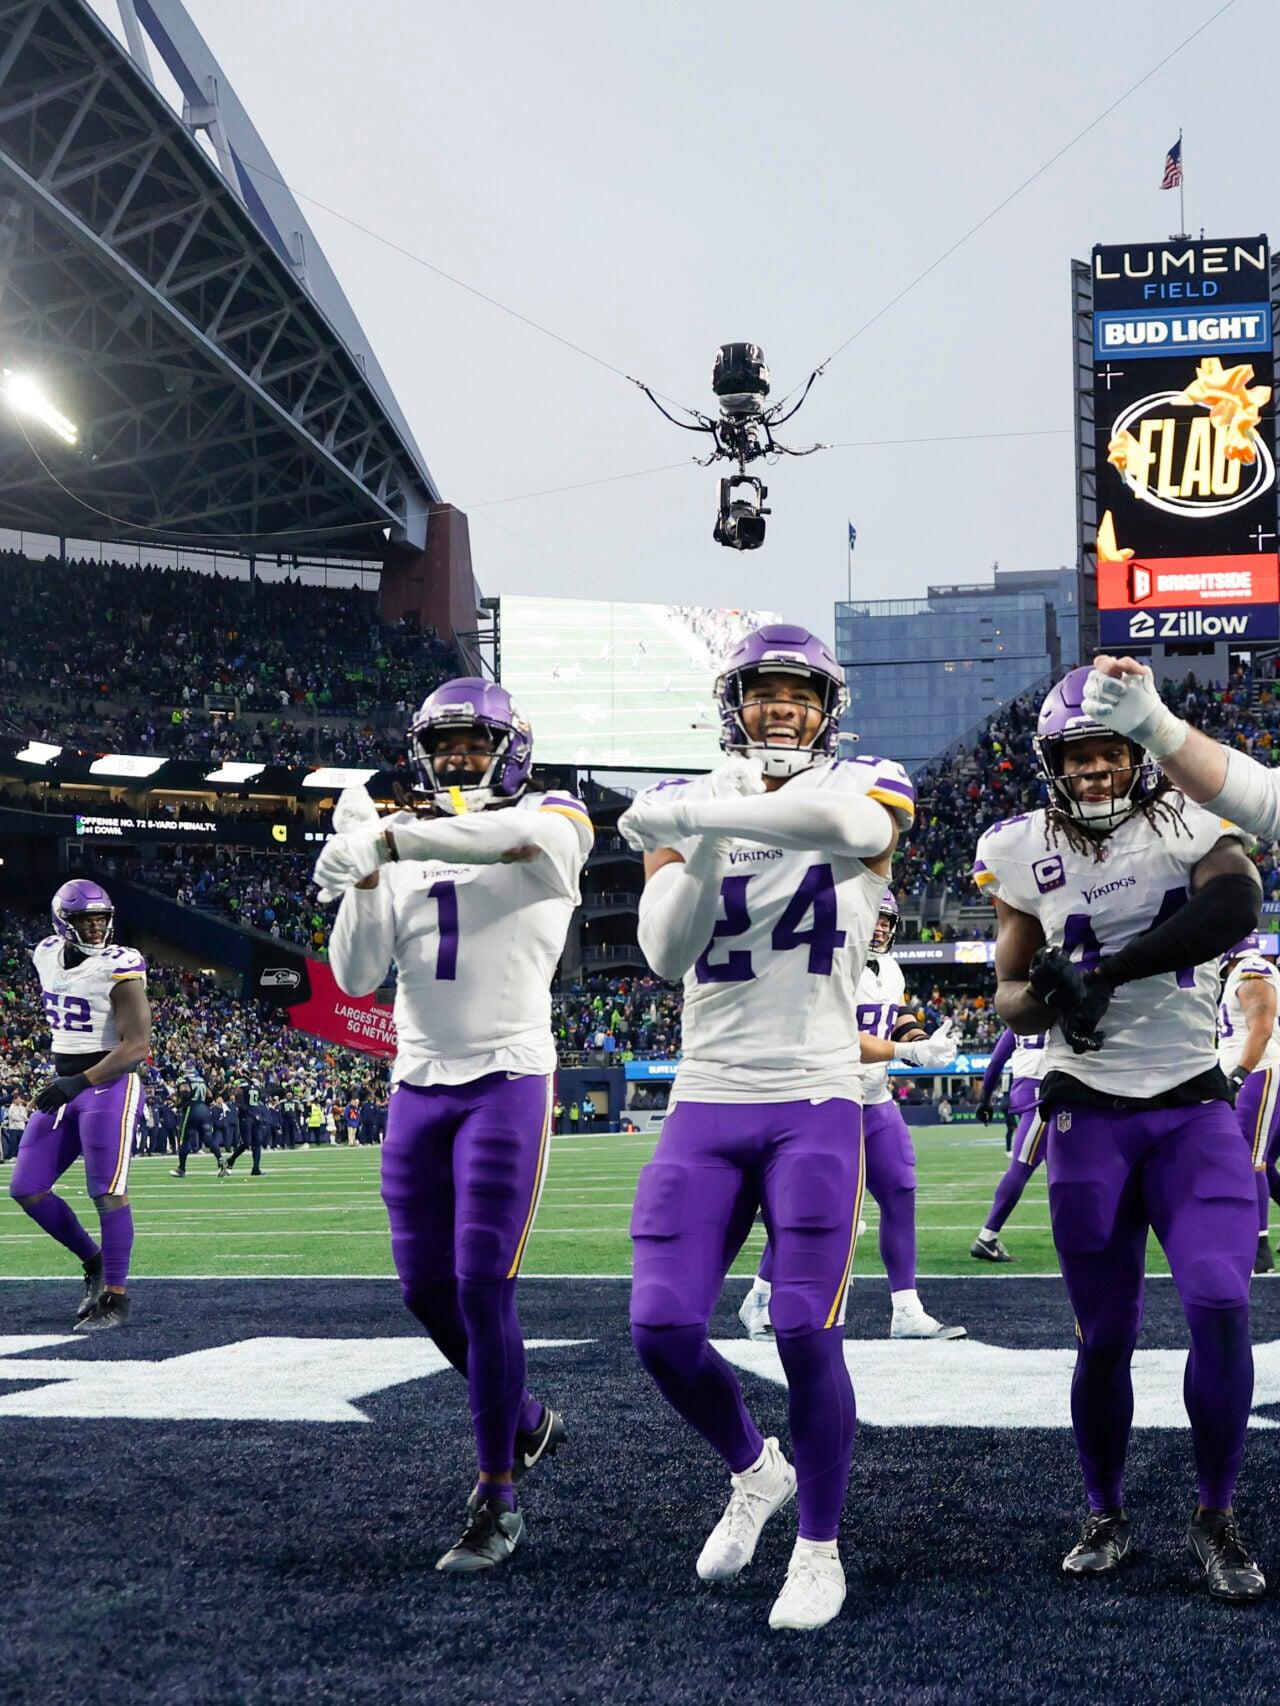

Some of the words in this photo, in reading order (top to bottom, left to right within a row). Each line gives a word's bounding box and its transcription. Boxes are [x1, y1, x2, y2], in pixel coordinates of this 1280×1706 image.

[1095, 244, 1266, 279] LUMEN
[1143, 281, 1219, 300] FIELD
[1104, 321, 1168, 346] BUD
[1172, 316, 1260, 342] LIGHT
[1157, 571, 1253, 592] BRIGHTSIDE
[1159, 611, 1249, 637] Zillow
[80, 816, 119, 826] OFFENSE
[136, 819, 147, 828] 72
[427, 880, 459, 981] 1
[695, 863, 847, 984] 24
[891, 950, 944, 959] AHAWKS
[41, 991, 93, 1033] 52
[335, 1003, 379, 1026] LARGEST
[379, 1017, 387, 1030] &
[347, 1020, 361, 1033] 5G
[362, 1025, 398, 1046] NETWO
